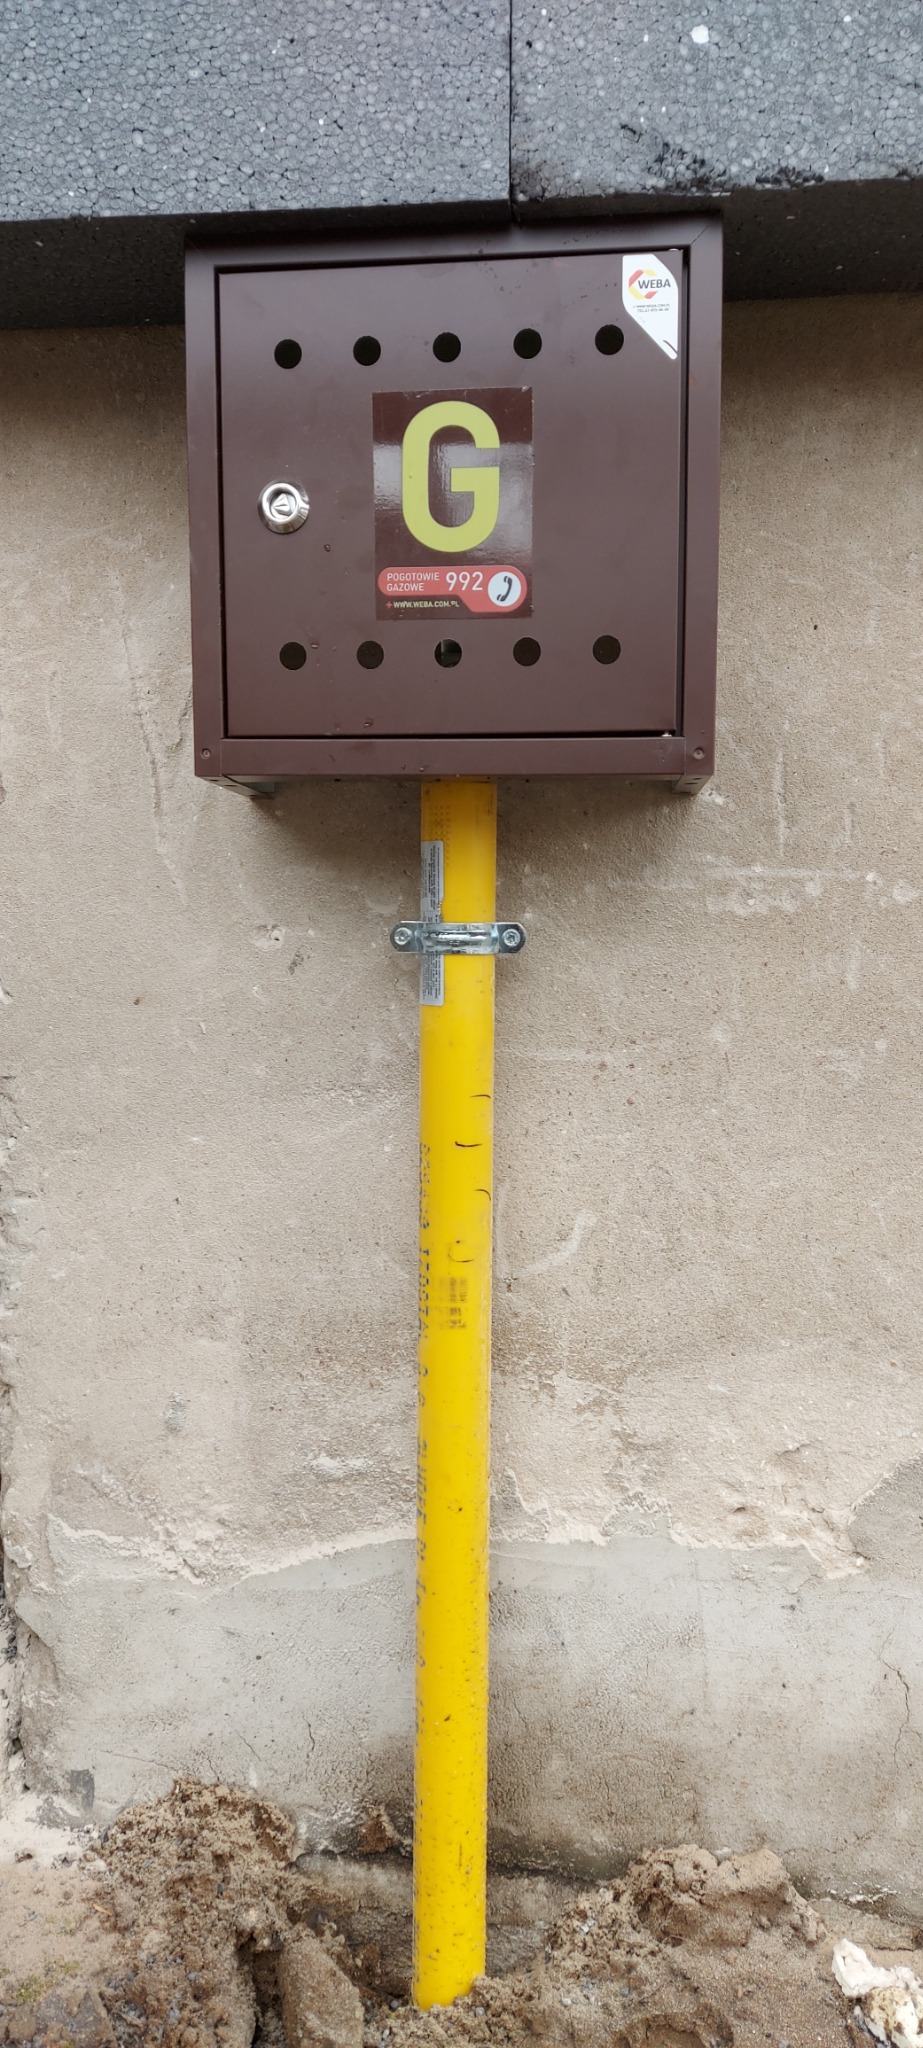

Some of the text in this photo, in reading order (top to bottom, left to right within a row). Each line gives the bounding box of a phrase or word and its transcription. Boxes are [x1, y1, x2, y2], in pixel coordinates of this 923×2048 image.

[638, 278, 671, 290] WEBA
[402, 400, 500, 553] G
[386, 571, 440, 582] POGOTOWIE
[445, 571, 484, 591] 992
[386, 582, 425, 592] GAZOWE
